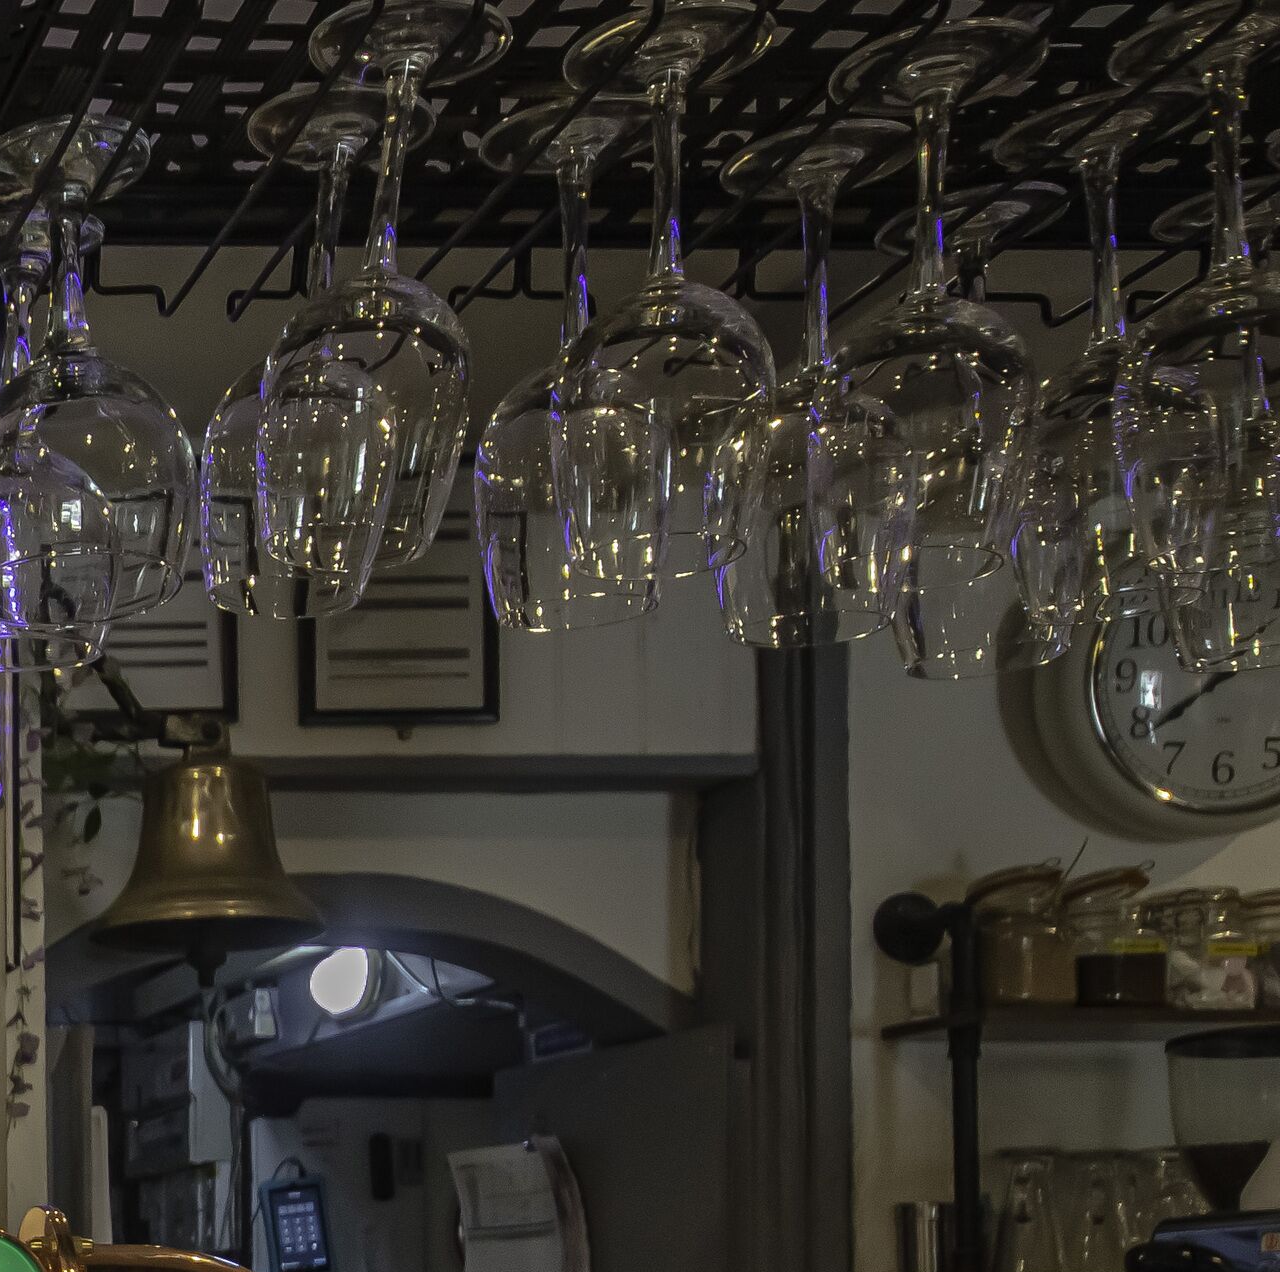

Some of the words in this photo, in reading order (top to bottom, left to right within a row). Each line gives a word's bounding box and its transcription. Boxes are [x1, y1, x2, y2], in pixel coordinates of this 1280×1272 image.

[1128, 616, 1169, 649] 10
[1115, 658, 1138, 693] 9
[1129, 706, 1151, 739] 8
[1162, 739, 1186, 775] 7
[1211, 750, 1236, 785] 6
